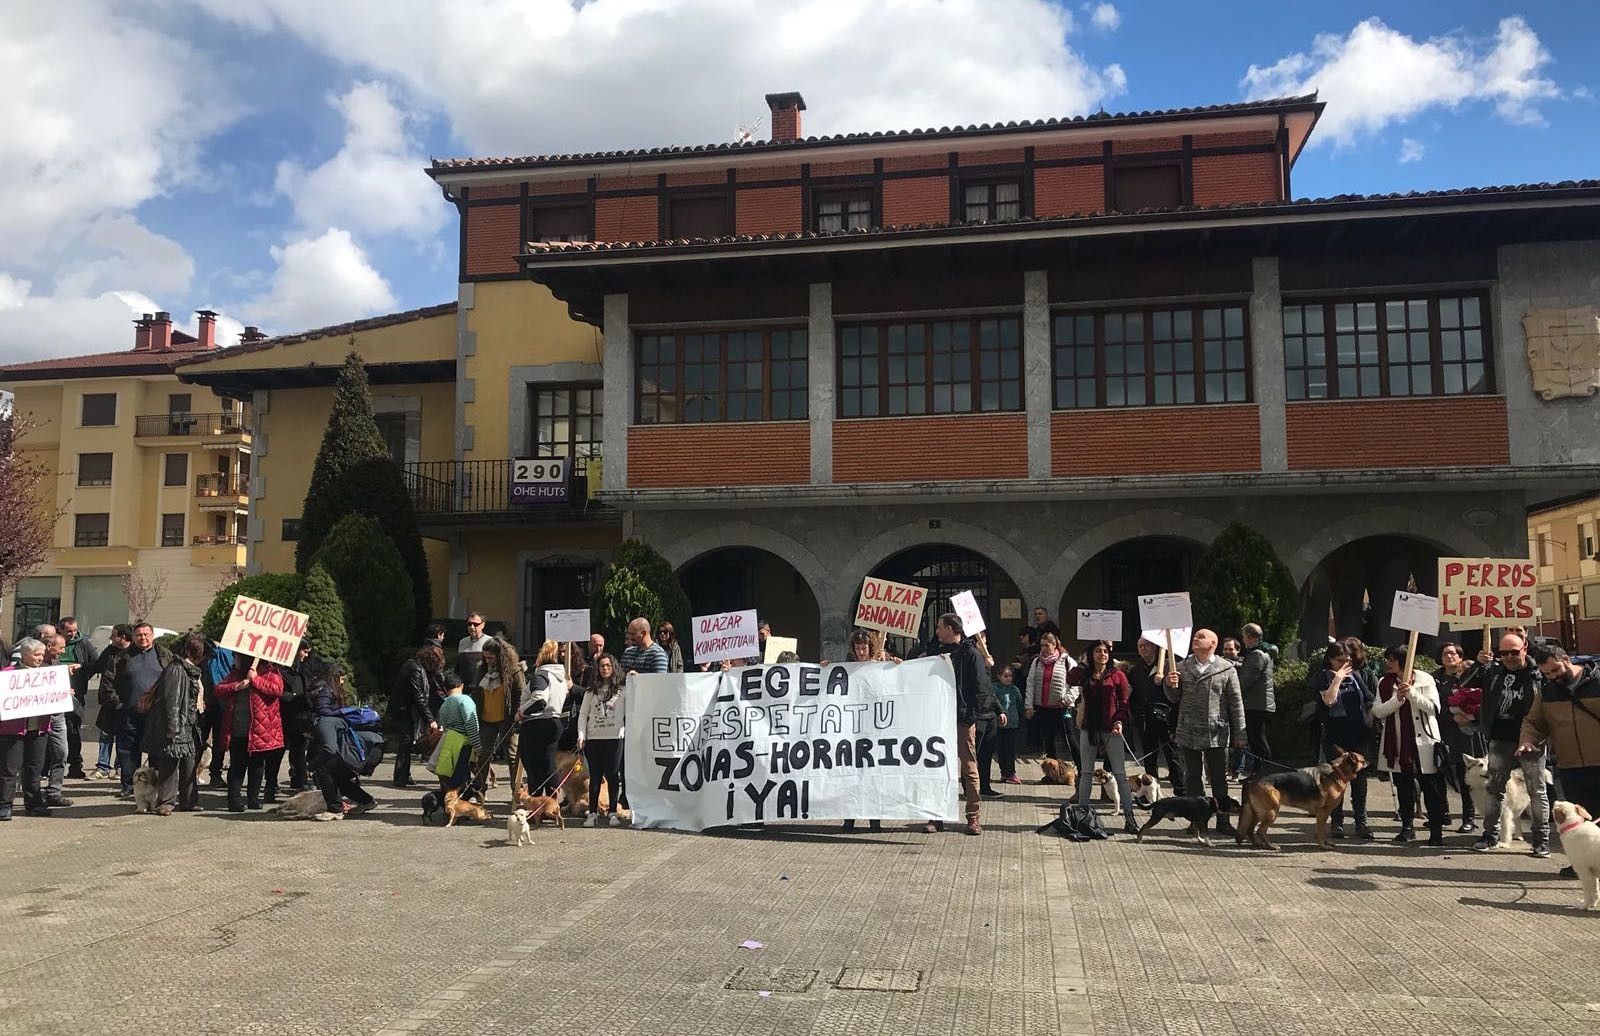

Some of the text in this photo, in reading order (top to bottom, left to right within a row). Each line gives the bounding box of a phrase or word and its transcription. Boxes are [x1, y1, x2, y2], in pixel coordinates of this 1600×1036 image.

[517, 464, 561, 479] 290
[513, 487, 566, 497] OHE HUTS
[1445, 562, 1537, 588] PERROS
[864, 582, 923, 607] OLAZAR
[700, 615, 742, 634] OLAZAR
[857, 603, 917, 634] DENONA!!
[9, 671, 57, 690] OLAZAR
